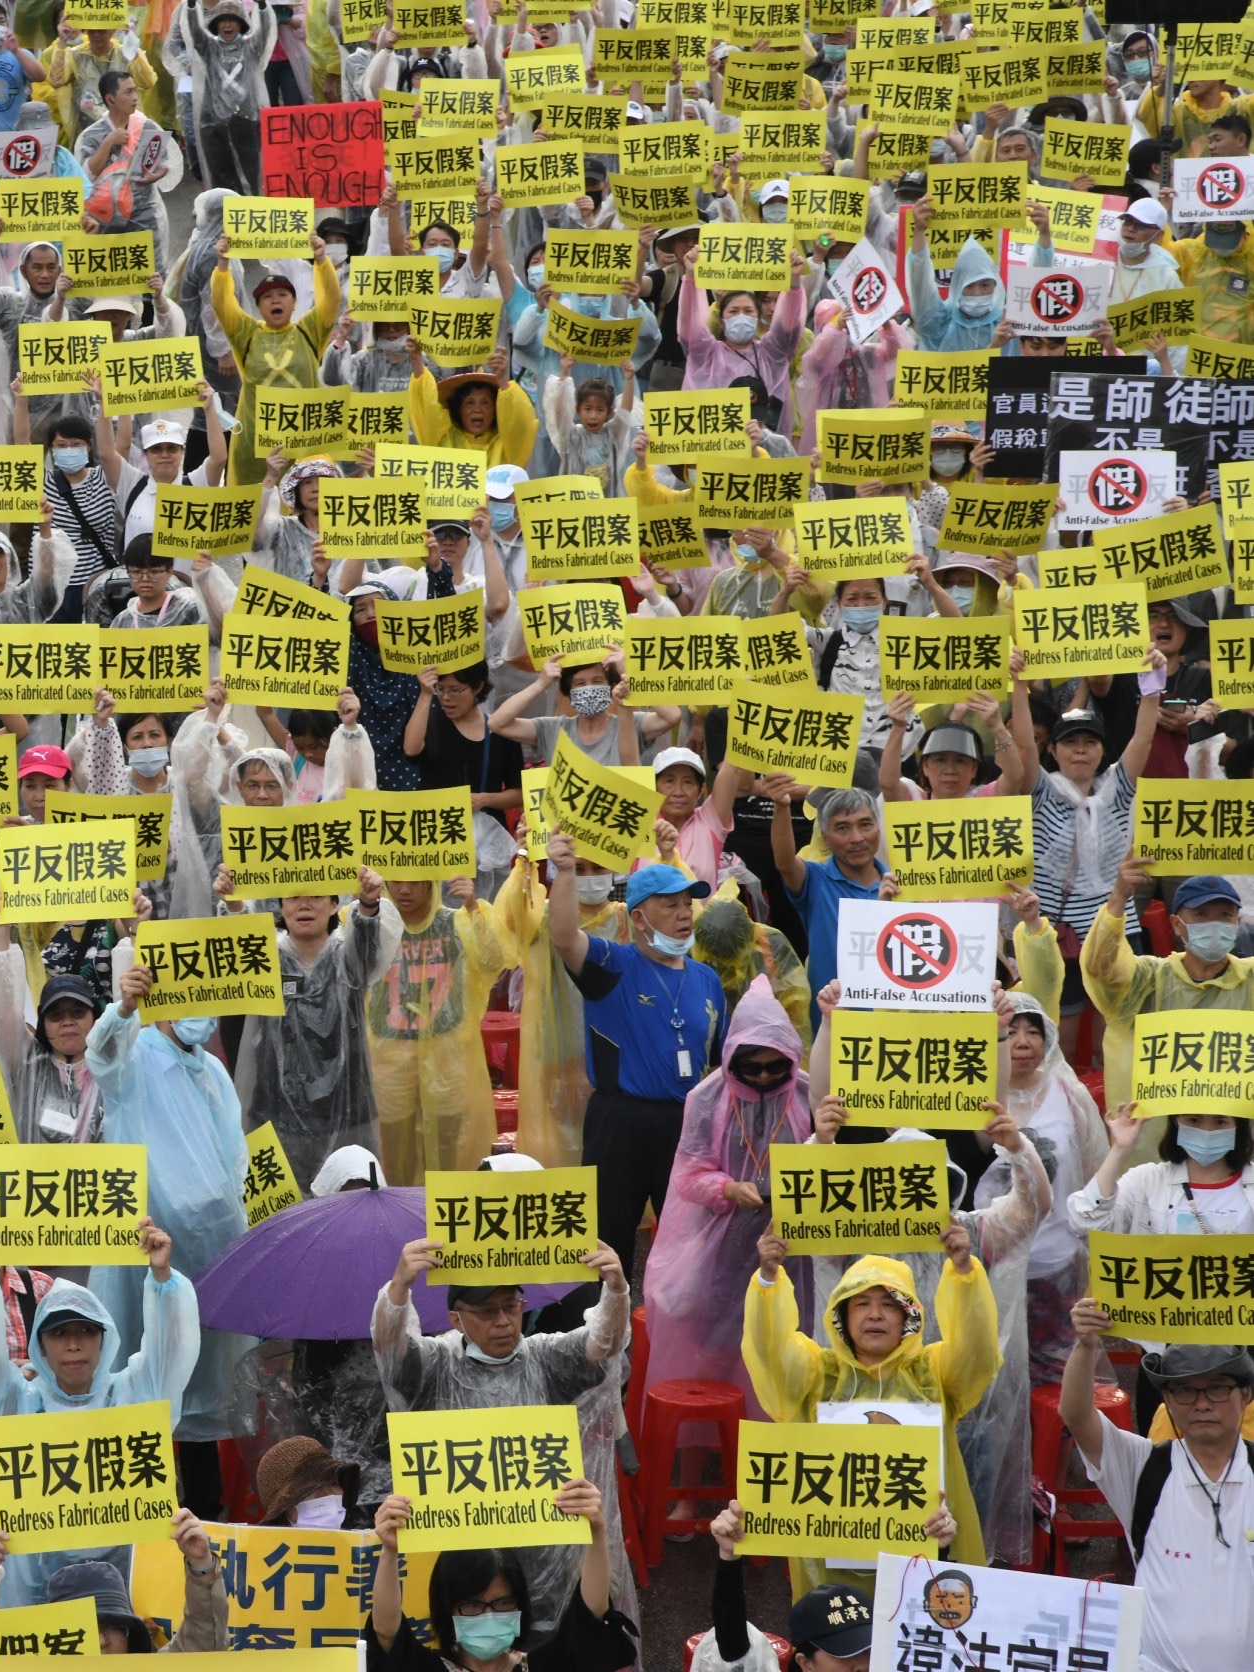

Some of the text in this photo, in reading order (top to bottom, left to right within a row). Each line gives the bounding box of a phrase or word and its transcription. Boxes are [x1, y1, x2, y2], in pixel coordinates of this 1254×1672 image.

[267, 108, 383, 145] ENOUGH
[296, 144, 337, 172] IS
[500, 152, 579, 184] 平反假案
[266, 169, 382, 206] ENOUGH
[501, 182, 581, 198] Redress Fabricated Cases
[228, 209, 308, 233] 平反假案
[1178, 209, 1214, 219] Anti-False
[255, 237, 288, 248] Fabricated
[290, 238, 308, 248] Cases
[699, 236, 787, 265] 平反假案
[698, 266, 785, 280] Redress Fabricated Cases
[258, 400, 344, 432] 平反假案
[285, 433, 322, 448] Fabricated
[324, 432, 342, 444] Cases
[951, 497, 1050, 530] 平反假案
[1065, 514, 1110, 526] Anti-False
[801, 512, 905, 551] 平反假案
[944, 527, 1041, 547] Redress Fabricated Cases
[804, 549, 909, 570] Redress Fabricated Cases
[1021, 601, 1140, 643] 平反假案
[226, 633, 341, 675] 平反假案
[885, 634, 1002, 670] 平反假案
[1023, 643, 1143, 665] Redress Fabricated Cases
[225, 673, 339, 696] Redress Fabricated Cases
[885, 674, 1002, 691] Redress Fabricated Cases
[734, 698, 854, 750] 平反假案
[732, 737, 847, 773] Redress Fabricated Cases
[2, 839, 126, 884] 平反假案
[3, 885, 128, 908] Redress Fabricated Cases
[844, 987, 987, 1004] Anti-False Accusations
[779, 1163, 938, 1214] 平反假案
[781, 1217, 941, 1240] Redress Fabricated Cases
[746, 1451, 928, 1510] 平反假案
[0, 1497, 173, 1533] Redress Fabricated Cases
[743, 1511, 928, 1542] Redress Fabricated Cases
